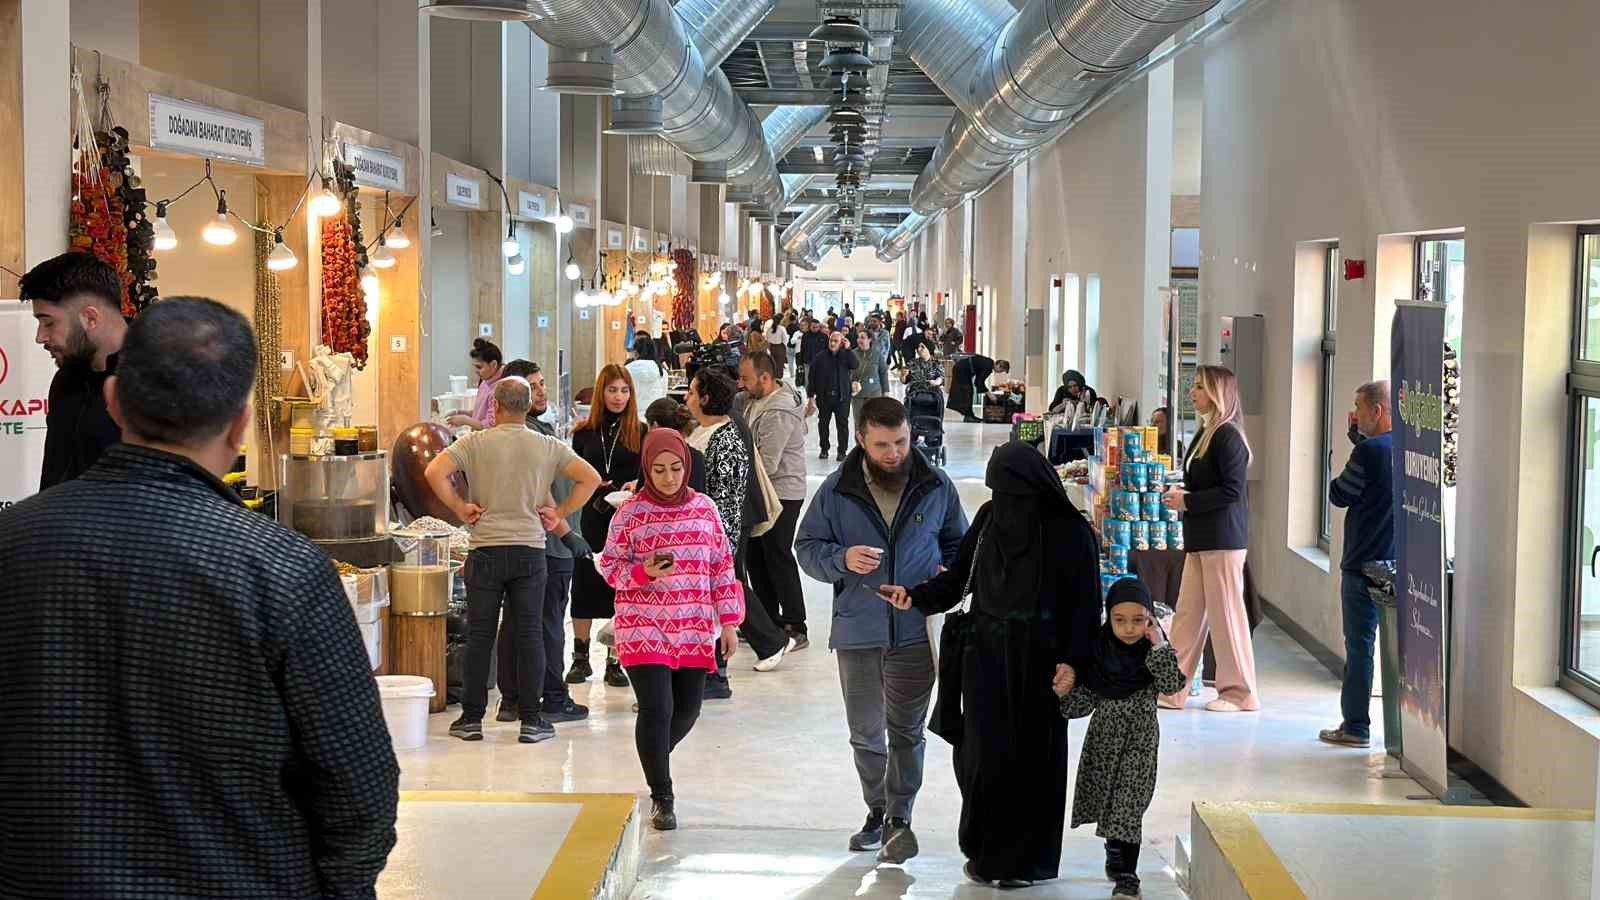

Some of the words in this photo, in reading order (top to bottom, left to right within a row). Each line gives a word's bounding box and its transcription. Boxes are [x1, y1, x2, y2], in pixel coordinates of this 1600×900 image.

[168, 112, 198, 138] DOĞADAN
[199, 121, 224, 143] BAHARAT
[224, 126, 252, 151] KURUYEMİŞ
[396, 340, 401, 348] 5
[0, 421, 24, 434] TE
